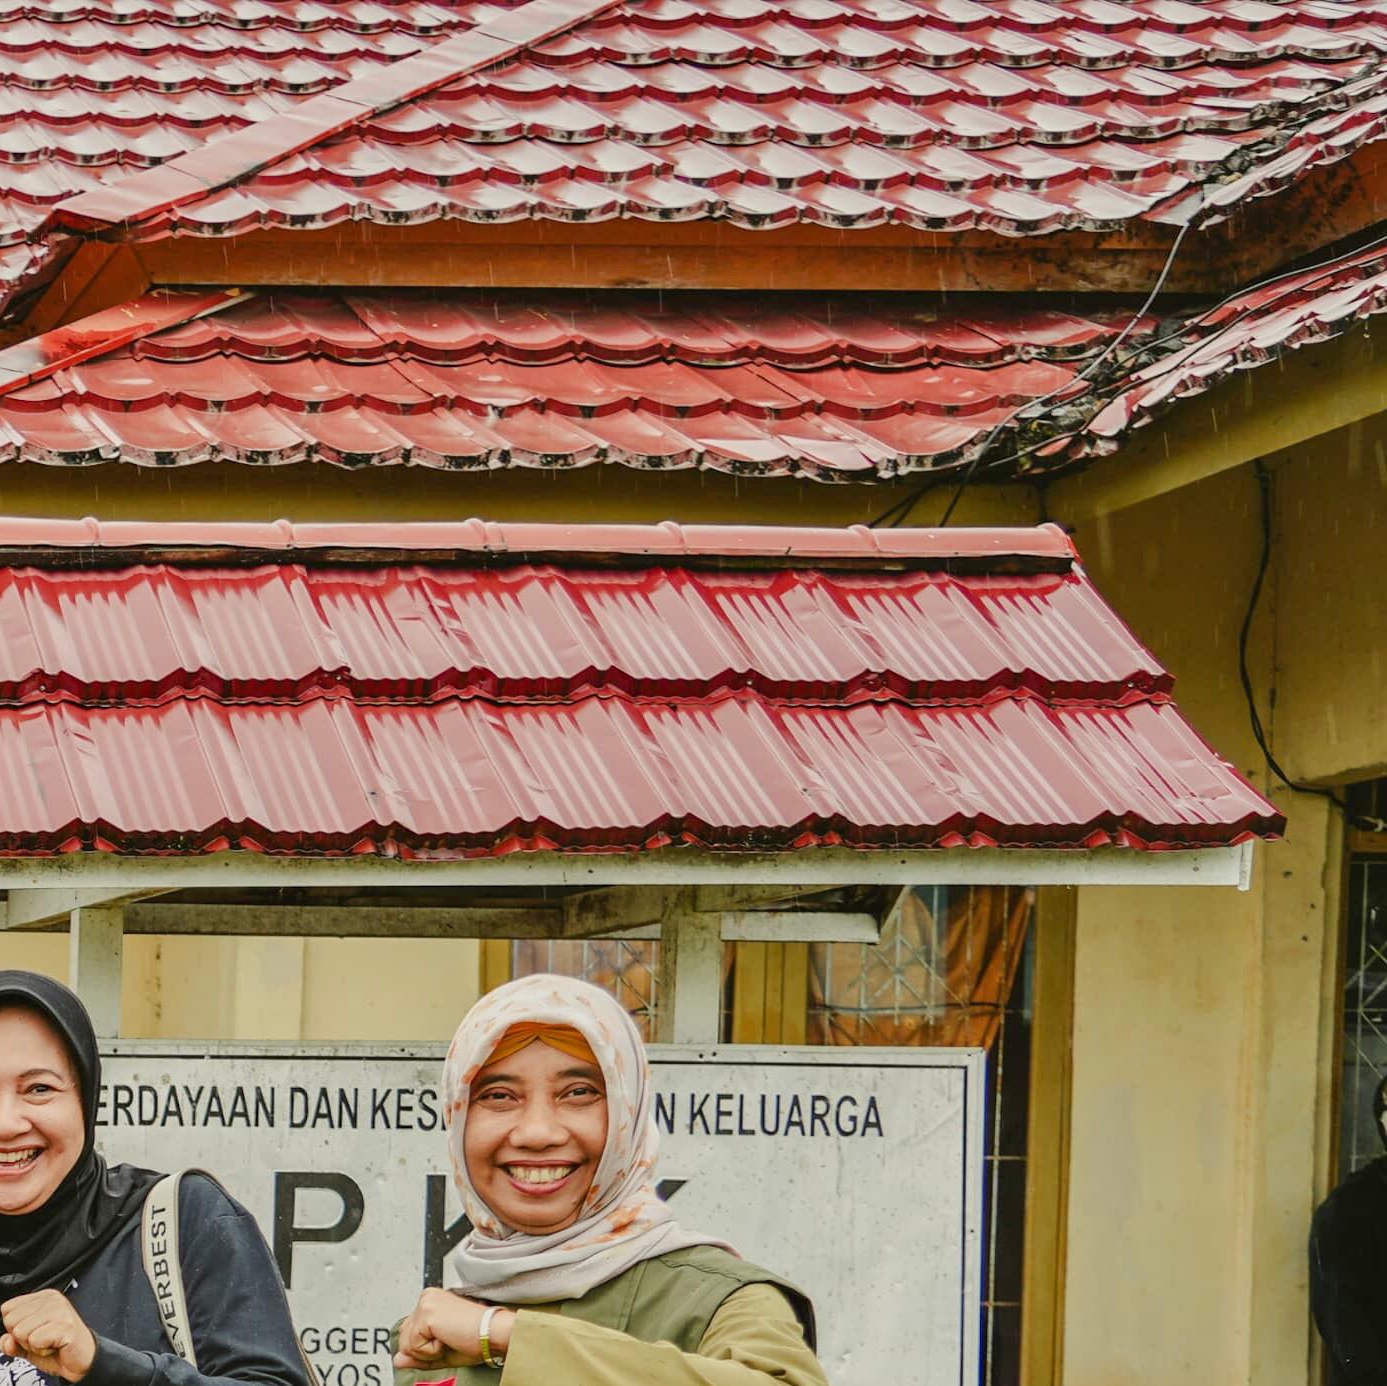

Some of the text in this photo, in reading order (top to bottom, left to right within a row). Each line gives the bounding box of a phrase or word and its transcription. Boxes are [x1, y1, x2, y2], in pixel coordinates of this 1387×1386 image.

[289, 1088, 358, 1130] DAN
[370, 1088, 447, 1131] KES
[688, 1092, 884, 1137] KELUARGA
